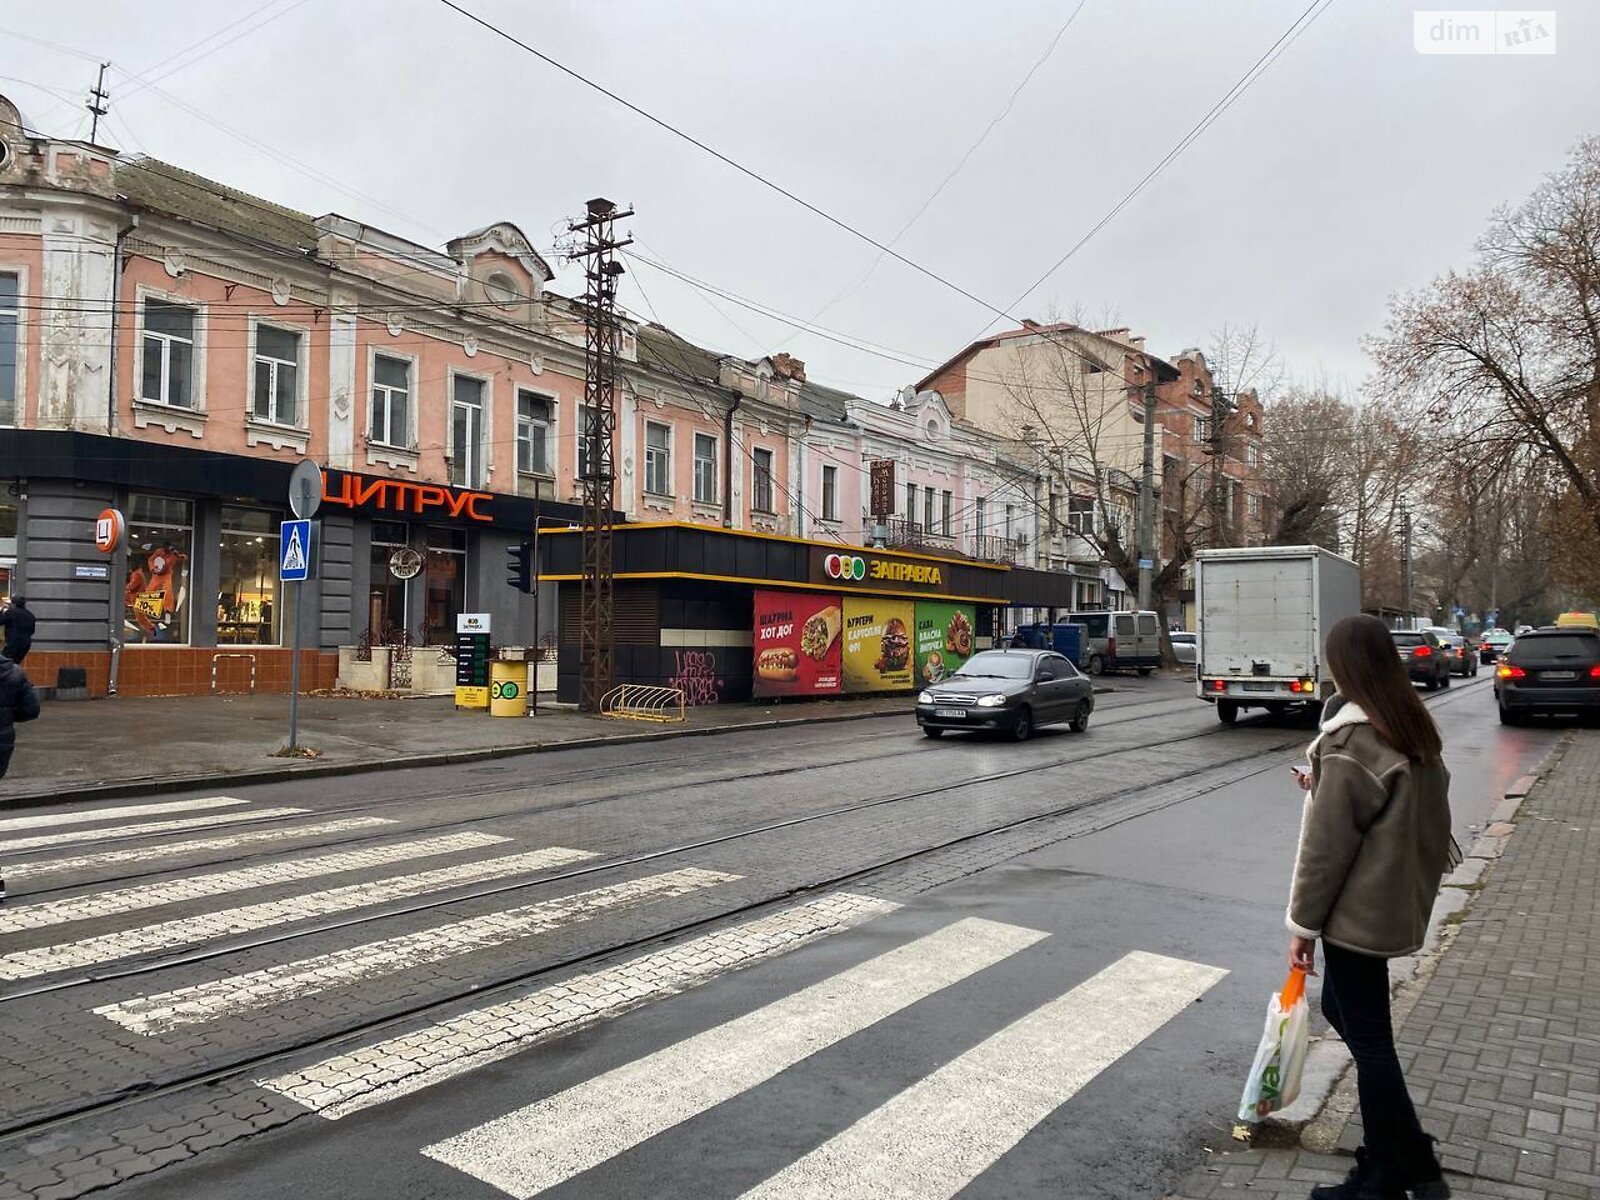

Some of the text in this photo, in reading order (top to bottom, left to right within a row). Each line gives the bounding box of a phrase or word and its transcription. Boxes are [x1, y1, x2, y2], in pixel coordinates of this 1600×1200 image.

[321, 471, 493, 521] ЦИТРУС
[869, 560, 942, 585] ЗАПРАВКА
[847, 614, 874, 628] БУРГЕРИ
[760, 624, 794, 640] ХОТ ДОГ
